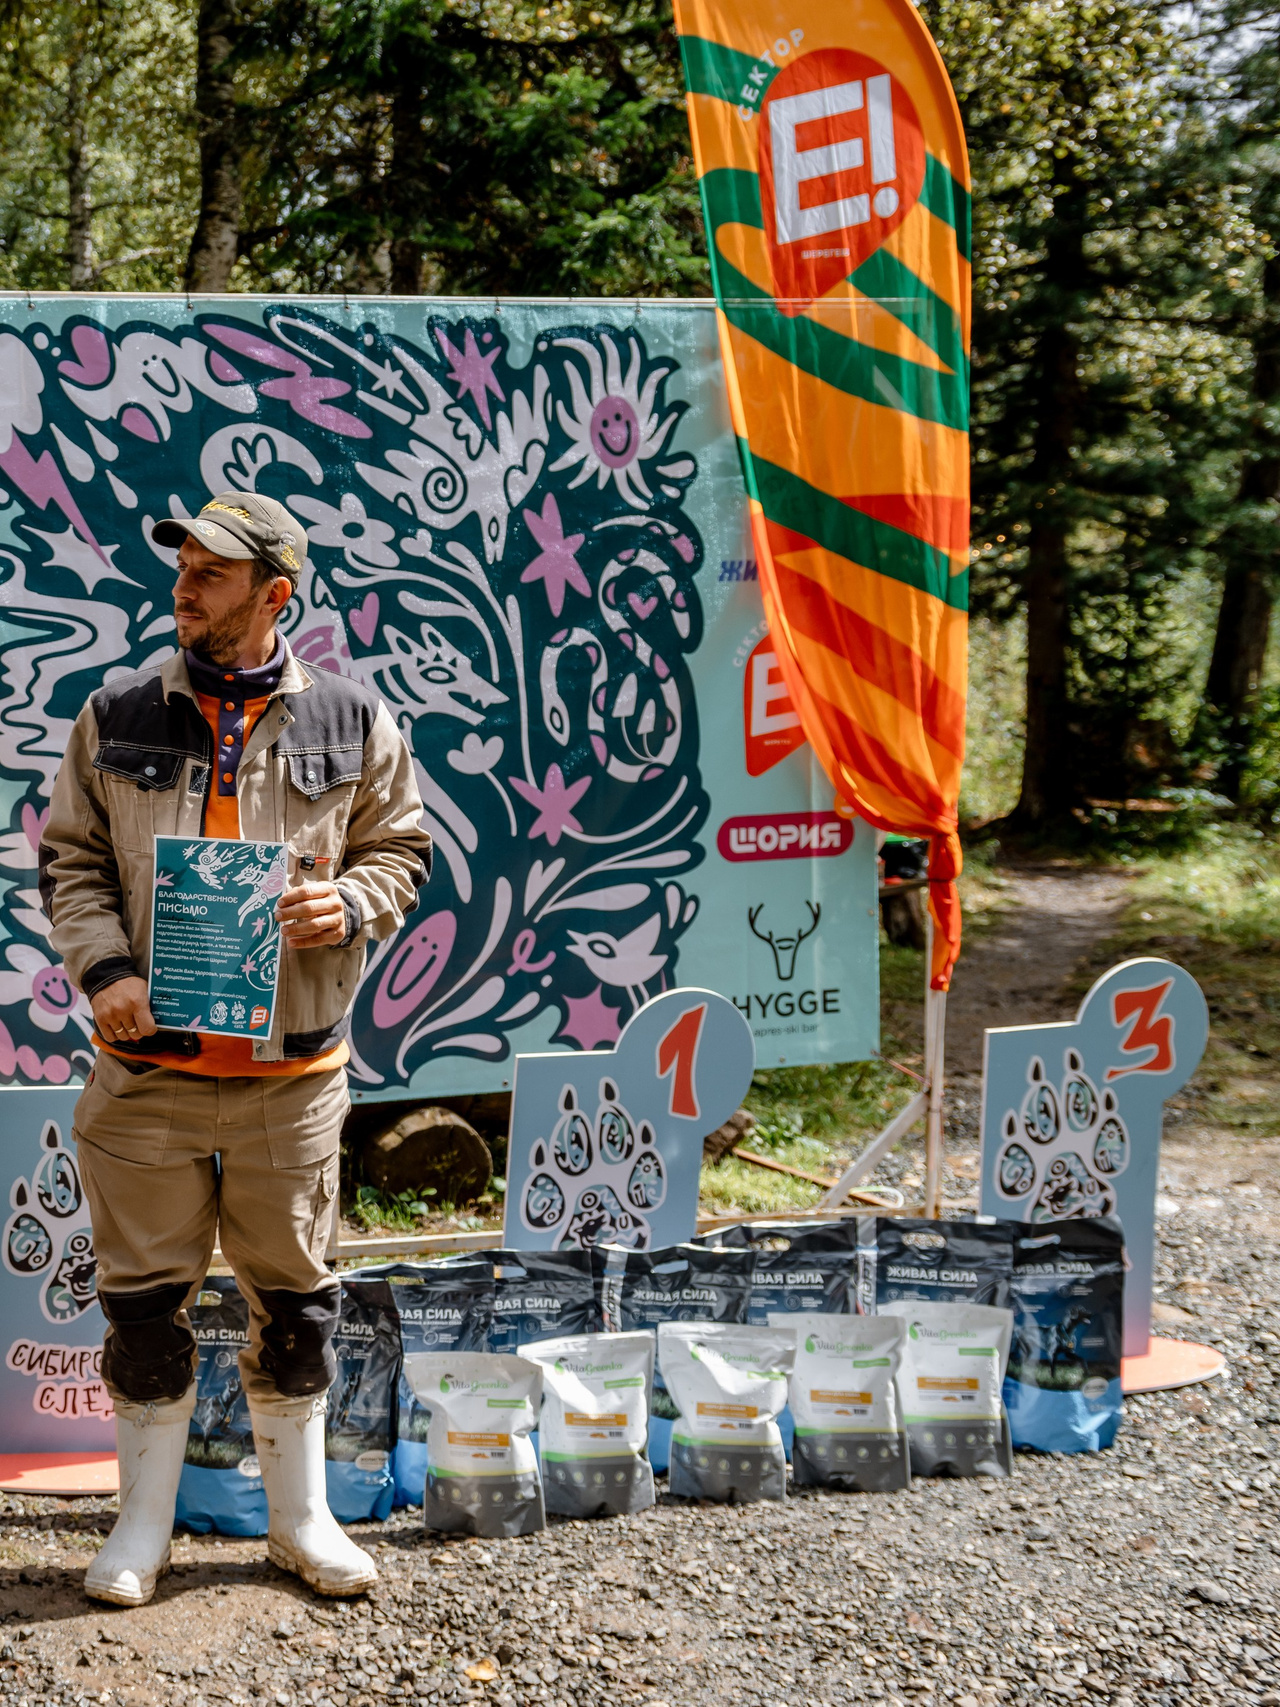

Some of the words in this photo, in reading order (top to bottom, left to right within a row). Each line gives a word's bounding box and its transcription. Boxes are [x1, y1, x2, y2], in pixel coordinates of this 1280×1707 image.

[737, 28, 805, 122] СЕКТОР
[801, 248, 851, 260] ШЕРЕГЕШ
[732, 620, 769, 668] СЕКТО
[729, 822, 841, 854] ШОРИЯ
[158, 890, 238, 904] БЛАГОДАРСТВЕННОЕ
[158, 903, 208, 917] ПИСЬМО
[732, 988, 840, 1019] HYGGE
[802, 1023, 818, 1034] bar
[1104, 977, 1176, 1083] 3
[656, 1001, 708, 1120] 1
[887, 1265, 937, 1281] ЖИВАЯ
[939, 1269, 978, 1284] СИЛА
[1015, 1263, 1054, 1275] ИВАЯ
[1058, 1262, 1094, 1274] СИЛА
[786, 1273, 824, 1285] СИЛА
[633, 1288, 679, 1302] ЖИВАЯ
[681, 1288, 717, 1301] СИЛА
[495, 1299, 520, 1311] ВАЯ
[525, 1298, 561, 1309] СИЛА
[426, 1309, 462, 1320] СИЛА
[219, 1329, 249, 1341] СИЛ
[341, 1323, 375, 1336] СИЛА
[39, 1385, 115, 1417] СЛЁ
